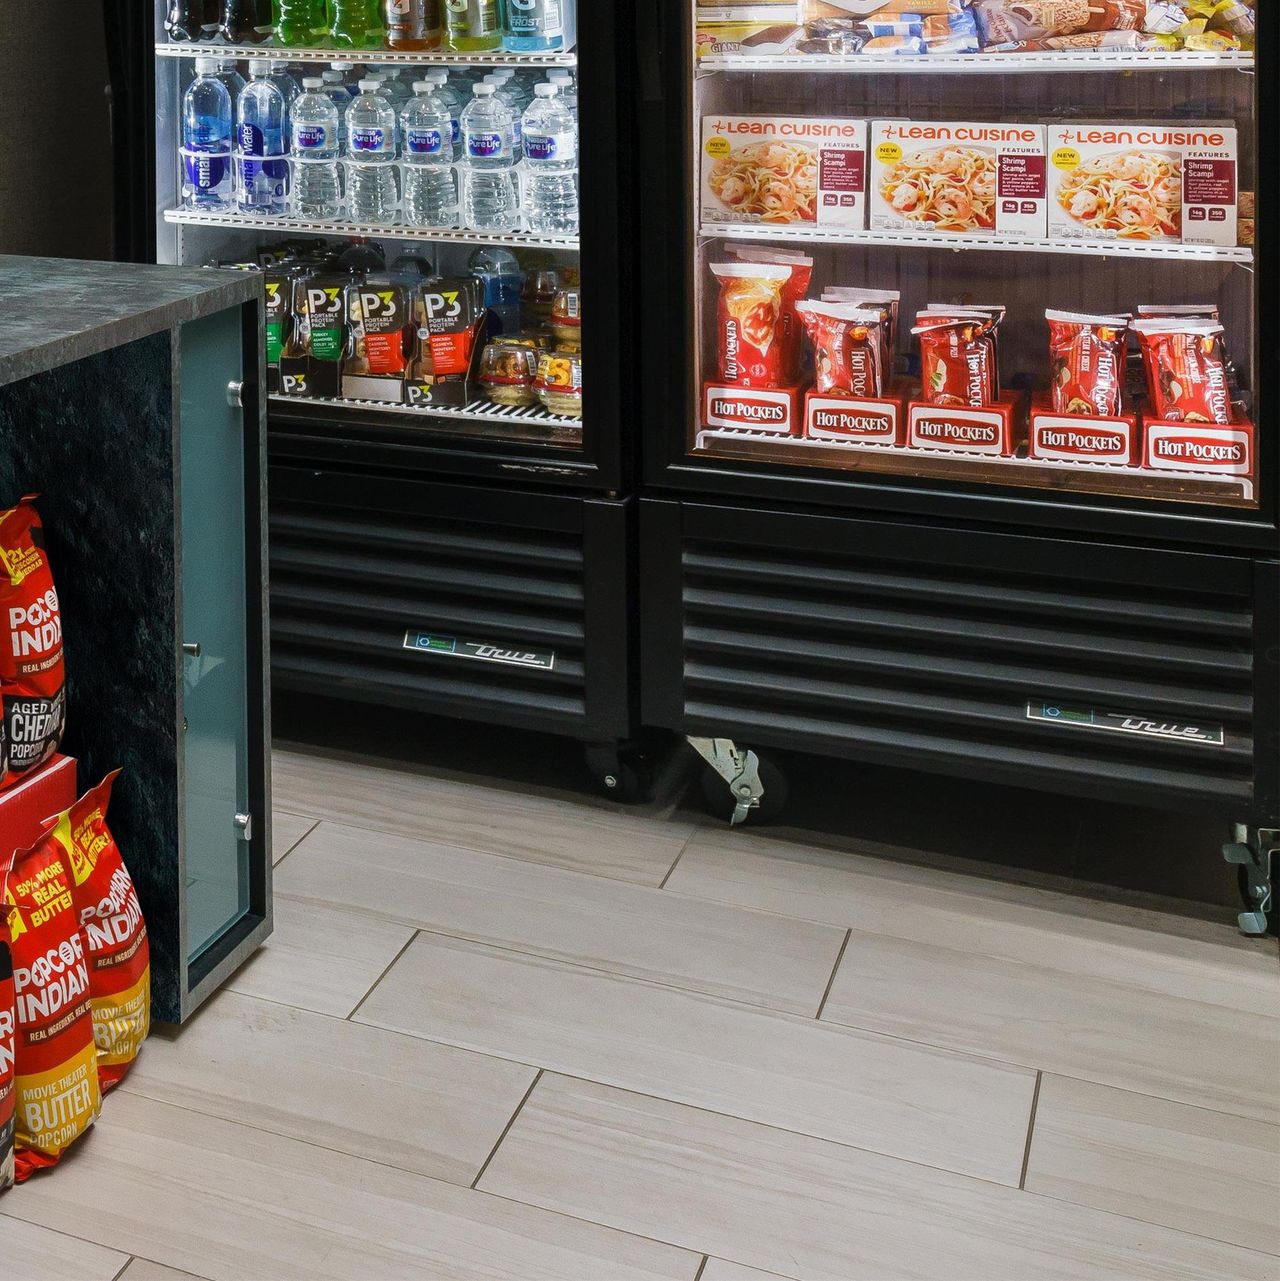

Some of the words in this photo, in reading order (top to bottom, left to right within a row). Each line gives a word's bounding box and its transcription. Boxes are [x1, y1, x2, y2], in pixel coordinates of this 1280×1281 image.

[510, 17, 541, 27] FROST
[370, 134, 384, 144] Life
[823, 152, 846, 160] Shrimp
[1001, 157, 1026, 166] Shrimp
[1188, 162, 1214, 171] Shrimp
[308, 287, 341, 314] P3
[361, 291, 397, 318] P3
[282, 374, 307, 393] P3
[714, 401, 736, 415] HOT
[736, 403, 783, 421] POCKETS
[816, 411, 839, 427] HOT
[839, 413, 889, 432] POCKETS
[920, 420, 944, 437] HOT
[944, 423, 995, 442] POCKETS
[1042, 430, 1067, 445] HOT
[1068, 432, 1121, 451] POCKETS
[1158, 440, 1184, 457] HOT
[1185, 442, 1241, 461] POCKETS
[32, 881, 66, 905] REAL
[97, 957, 115, 967] REAL
[92, 1006, 122, 1021] MOVIE
[24, 1076, 93, 1134] BUTTER
[29, 1120, 78, 1148] POPCORN
